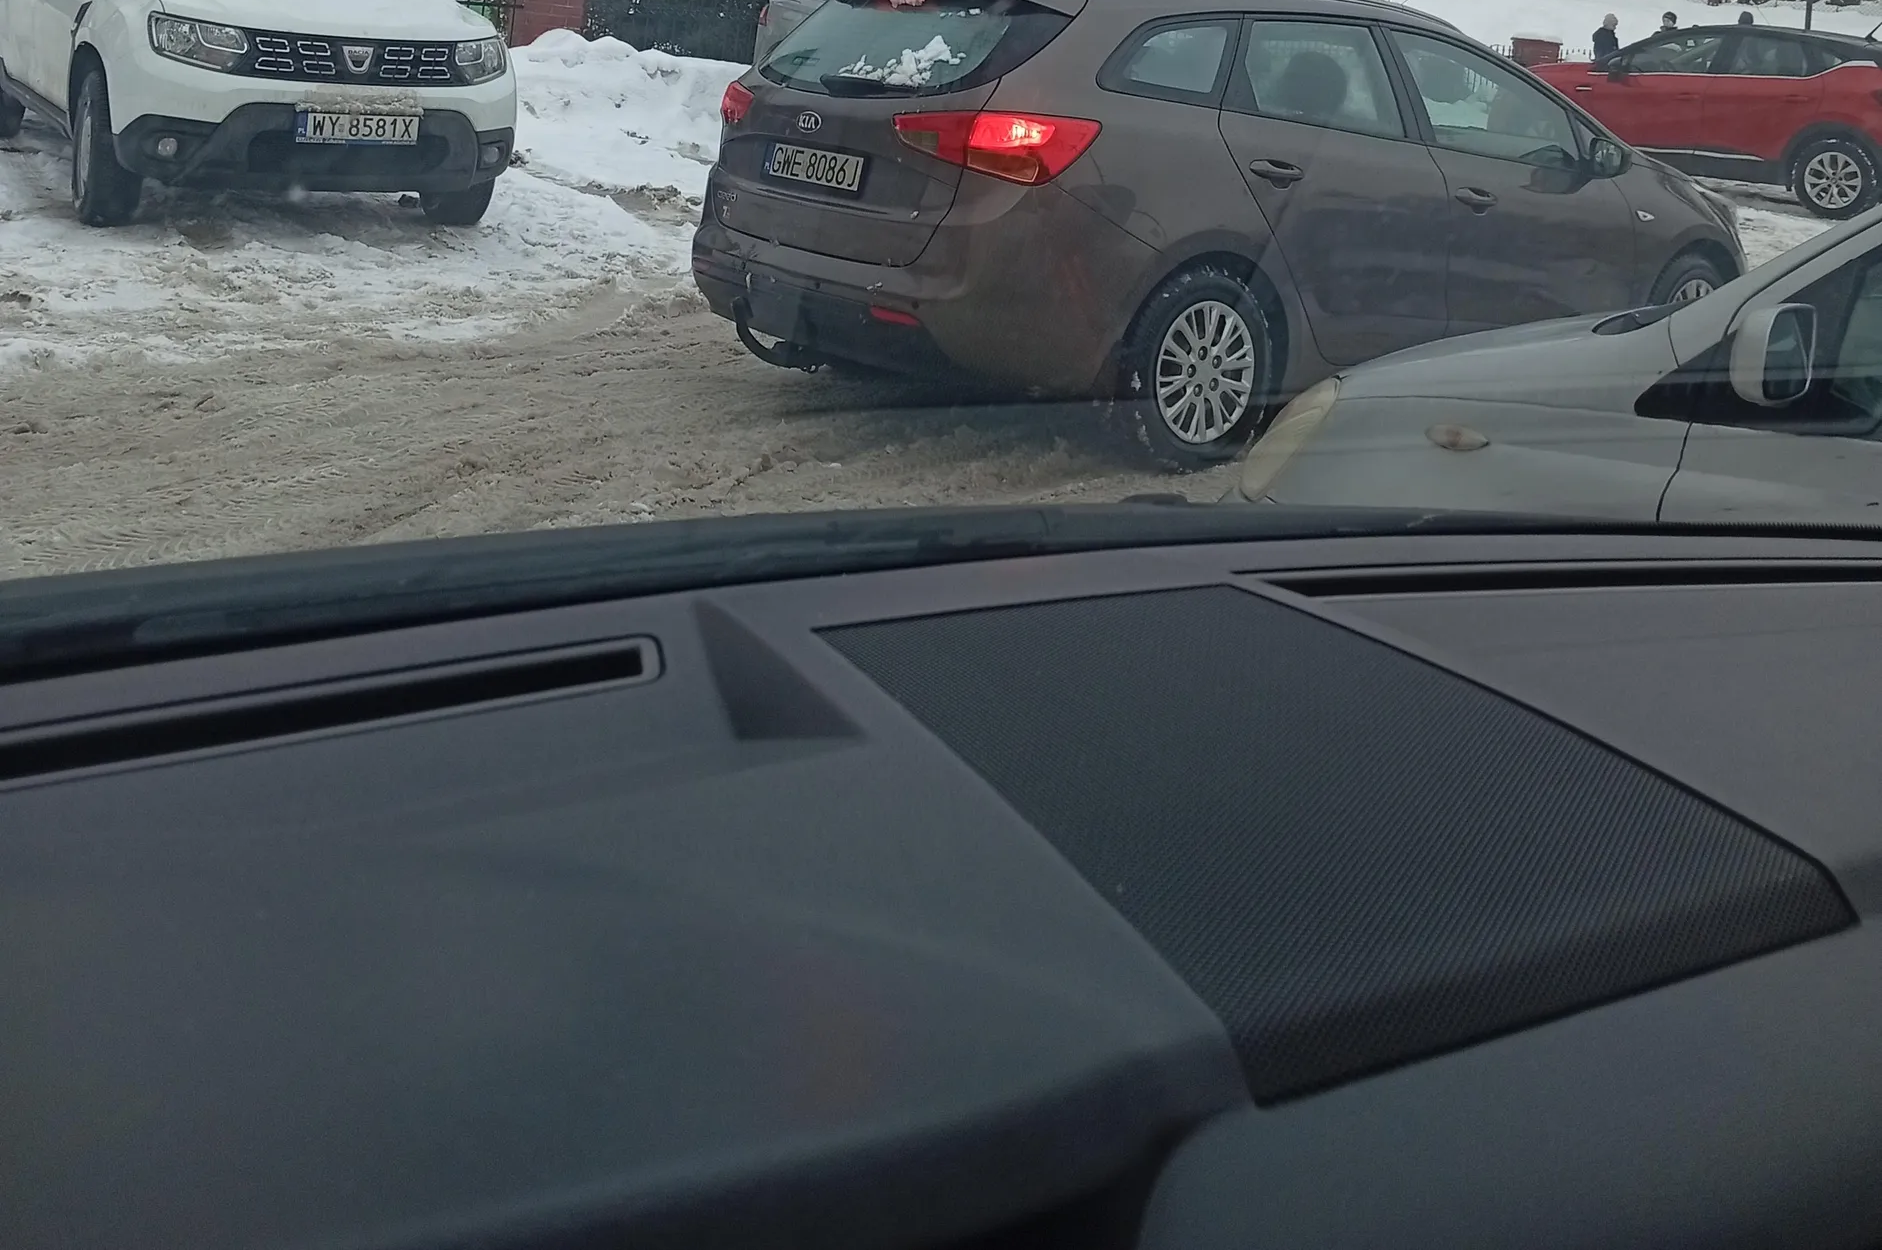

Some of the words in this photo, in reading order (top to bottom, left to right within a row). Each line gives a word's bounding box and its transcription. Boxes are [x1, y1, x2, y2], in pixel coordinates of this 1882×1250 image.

[312, 115, 341, 136] WY
[348, 117, 413, 139] 8581X
[798, 115, 816, 129] KIA
[771, 147, 804, 177] GWE
[805, 152, 859, 187] 8086J
